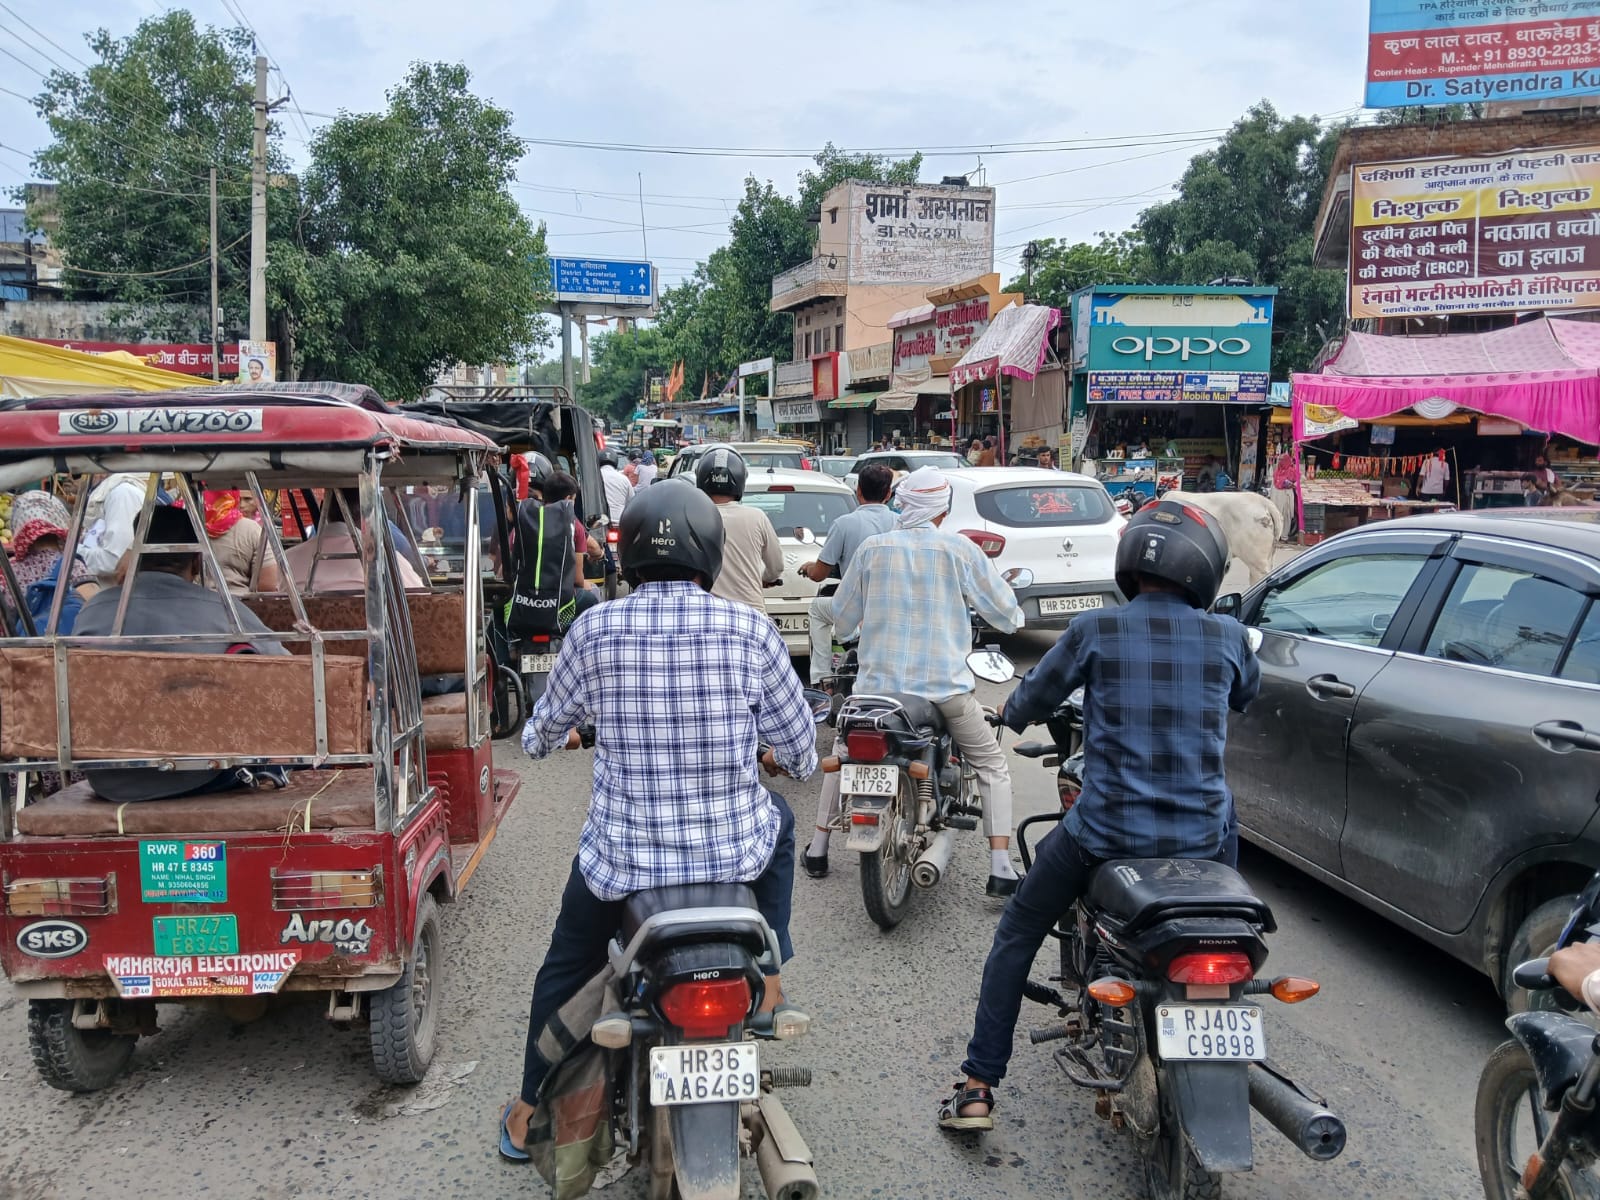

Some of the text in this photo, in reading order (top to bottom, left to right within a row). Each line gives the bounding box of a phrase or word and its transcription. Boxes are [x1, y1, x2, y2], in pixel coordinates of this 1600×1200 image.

[1418, 3, 1437, 11] TPA
[1384, 38, 1420, 56] कृष्ण
[1424, 35, 1460, 49] लाल
[1471, 50, 1502, 63] +91
[1374, 68, 1402, 78] Center
[1404, 66, 1427, 76] Head
[1438, 63, 1482, 75] Rupender
[1406, 81, 1436, 98] Dr.
[1444, 73, 1562, 98] Satyendra
[1360, 165, 1416, 183] दक्षिणी
[1420, 161, 1491, 180] हरियाणा
[1496, 156, 1515, 172] में
[1518, 152, 1565, 170] पहली
[865, 189, 911, 224] शर्मा
[1362, 224, 1405, 243] दूरबीन
[1407, 225, 1438, 242] द्वारा
[1484, 222, 1551, 243] नवजात
[1361, 238, 1468, 261] की थैली की नली
[1498, 245, 1586, 270] का इलाज
[1358, 259, 1470, 281] की सफाई (ERCP)
[1361, 284, 1402, 306] रेनबो
[1183, 391, 1210, 401] Mobile
[76, 409, 252, 433] SKS Arzoo
[516, 595, 558, 608] DRAGON
[1046, 599, 1059, 611] HR
[855, 767, 887, 780] HR36
[851, 780, 892, 793] N1762
[147, 844, 216, 859] RWR 360
[152, 863, 214, 872] HR 47 E 8345
[176, 918, 221, 936] HR47
[28, 930, 77, 950] SKS
[172, 935, 229, 954] E8345
[107, 953, 296, 976] MAHARAJA ELECTRONICS
[155, 976, 184, 988] GOKAL
[1185, 1009, 1252, 1031] RJ40S
[1188, 1034, 1255, 1057] C9898
[680, 1048, 740, 1073] HR36
[665, 1073, 755, 1101] AA6469
